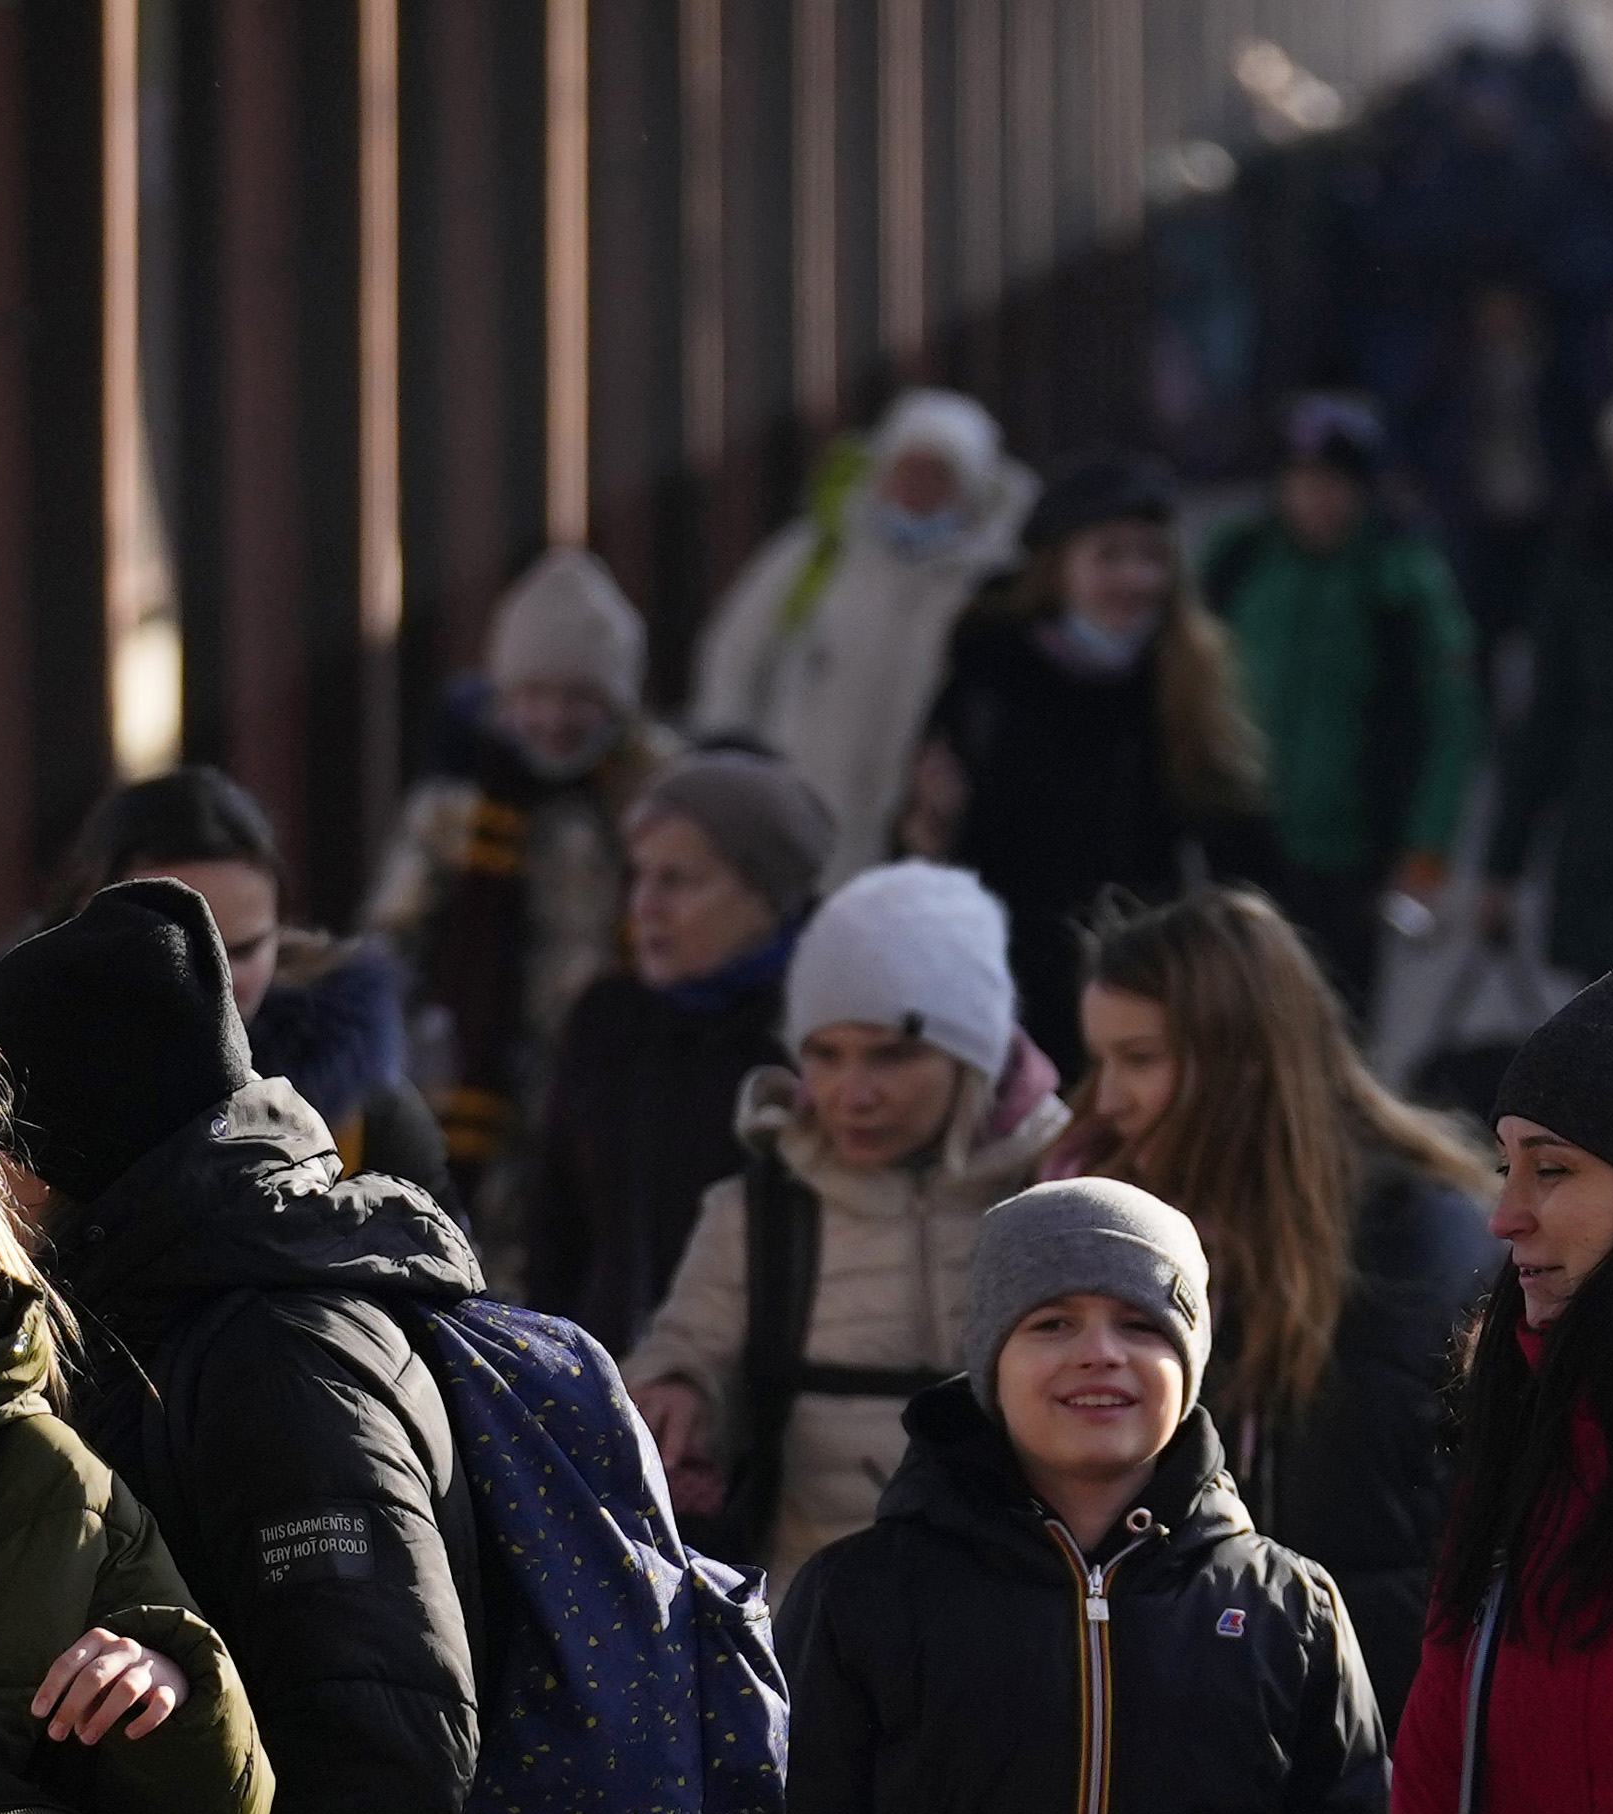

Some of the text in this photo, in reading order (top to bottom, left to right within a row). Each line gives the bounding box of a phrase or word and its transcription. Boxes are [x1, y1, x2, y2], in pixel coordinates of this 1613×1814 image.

[260, 1513, 365, 1543] THIS GARMENTS IS
[262, 1536, 368, 1565] VERY HOT OR COLD
